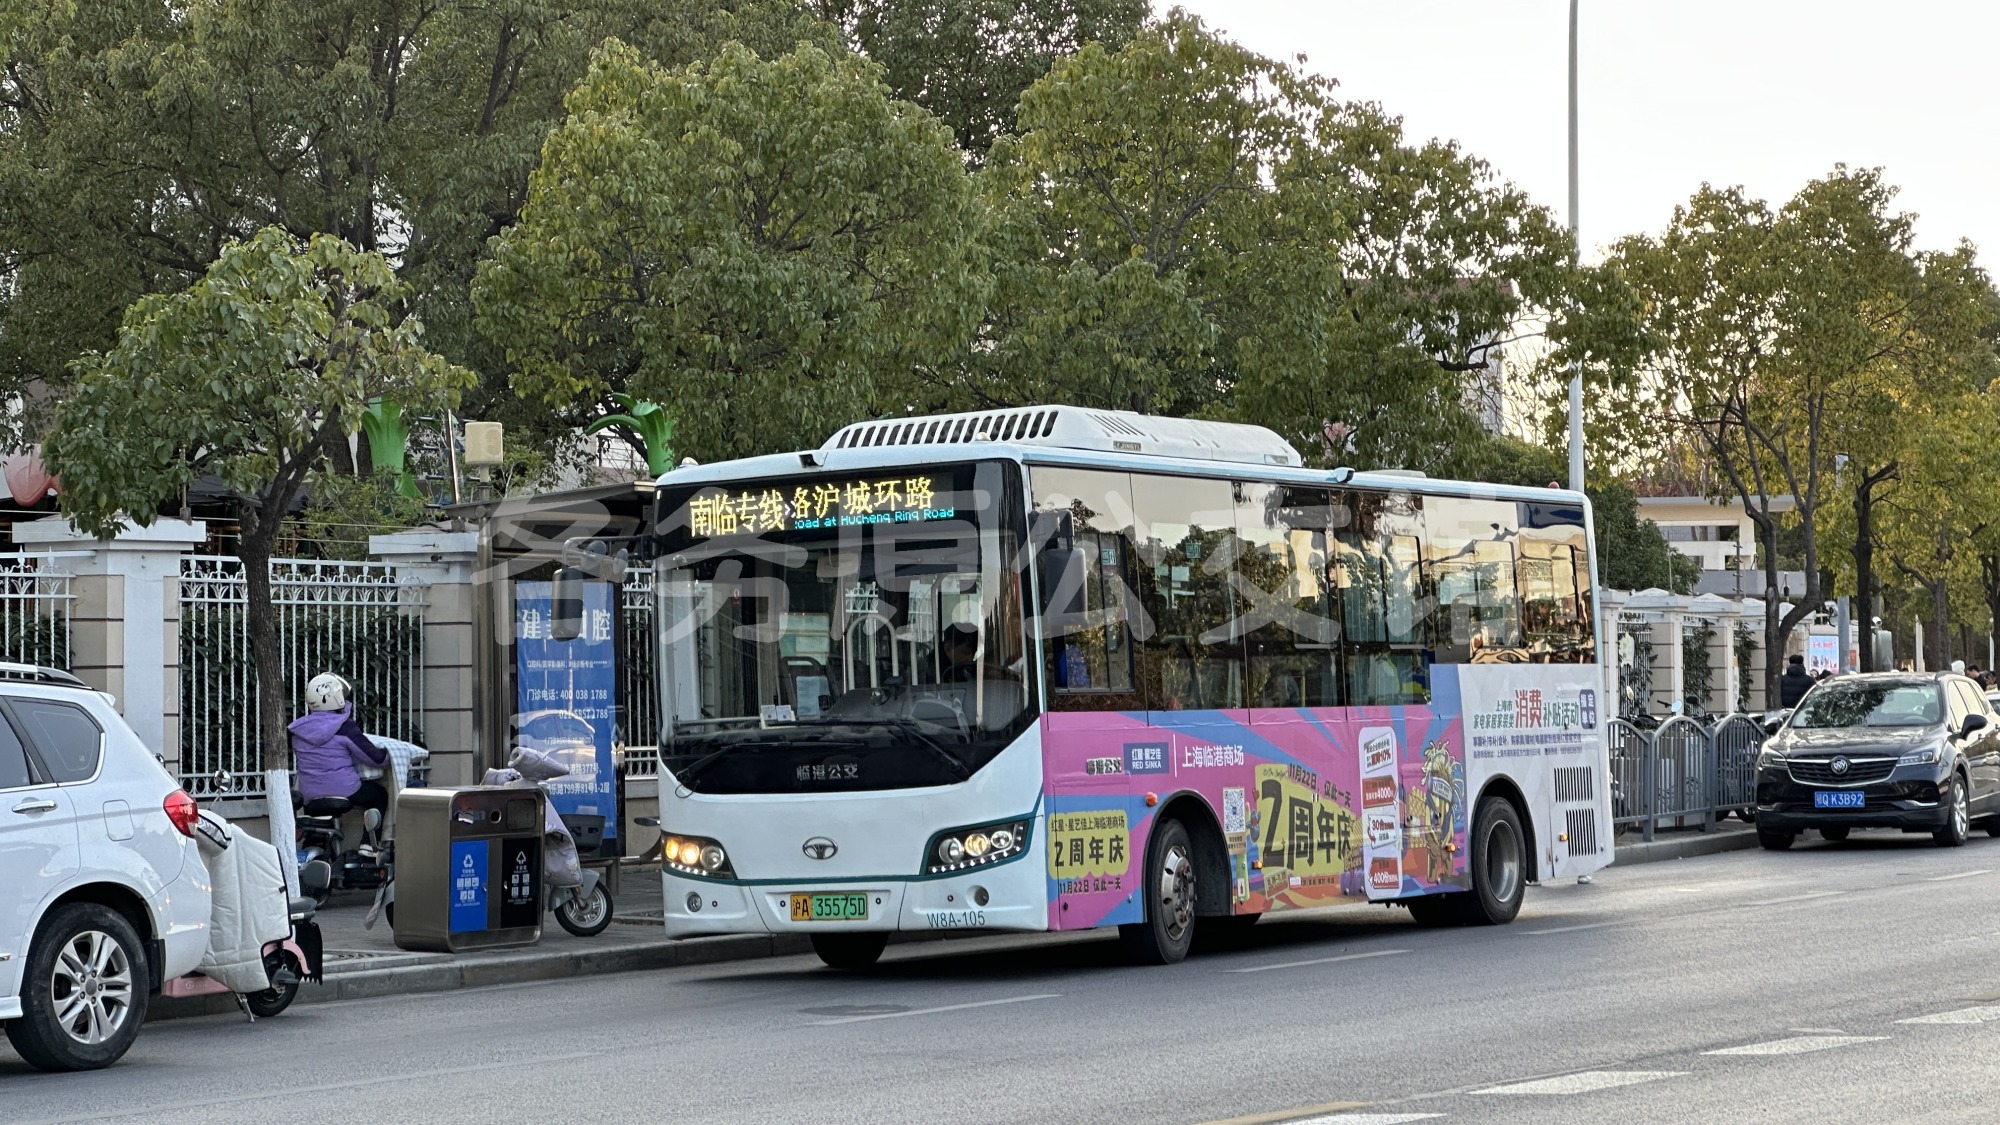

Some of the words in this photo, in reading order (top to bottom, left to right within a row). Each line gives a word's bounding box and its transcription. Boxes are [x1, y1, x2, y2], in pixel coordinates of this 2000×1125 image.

[690, 489, 785, 537] 南临专线
[794, 518, 820, 529] oad
[824, 517, 837, 527] at
[841, 511, 891, 525] Hucheng
[894, 509, 919, 521] Ring
[924, 507, 955, 519] Road
[575, 690, 588, 699] 038
[591, 690, 607, 699] 1788
[1495, 700, 1513, 711] 上海市
[1515, 689, 1542, 728] 消费
[1543, 702, 1579, 728] 补贴活动
[1132, 761, 1144, 769] RED
[1145, 760, 1162, 769] SINKA
[1182, 745, 1245, 768] 上海临港商场
[796, 764, 859, 781] 临港公交
[1324, 780, 1352, 808] 仅此一天
[1261, 778, 1352, 870] 2周年庆
[1054, 834, 1124, 867] 2周年庆
[1059, 880, 1089, 894] 11月22日
[1093, 877, 1122, 892] 仅此一天
[927, 910, 986, 928] W8A-105
